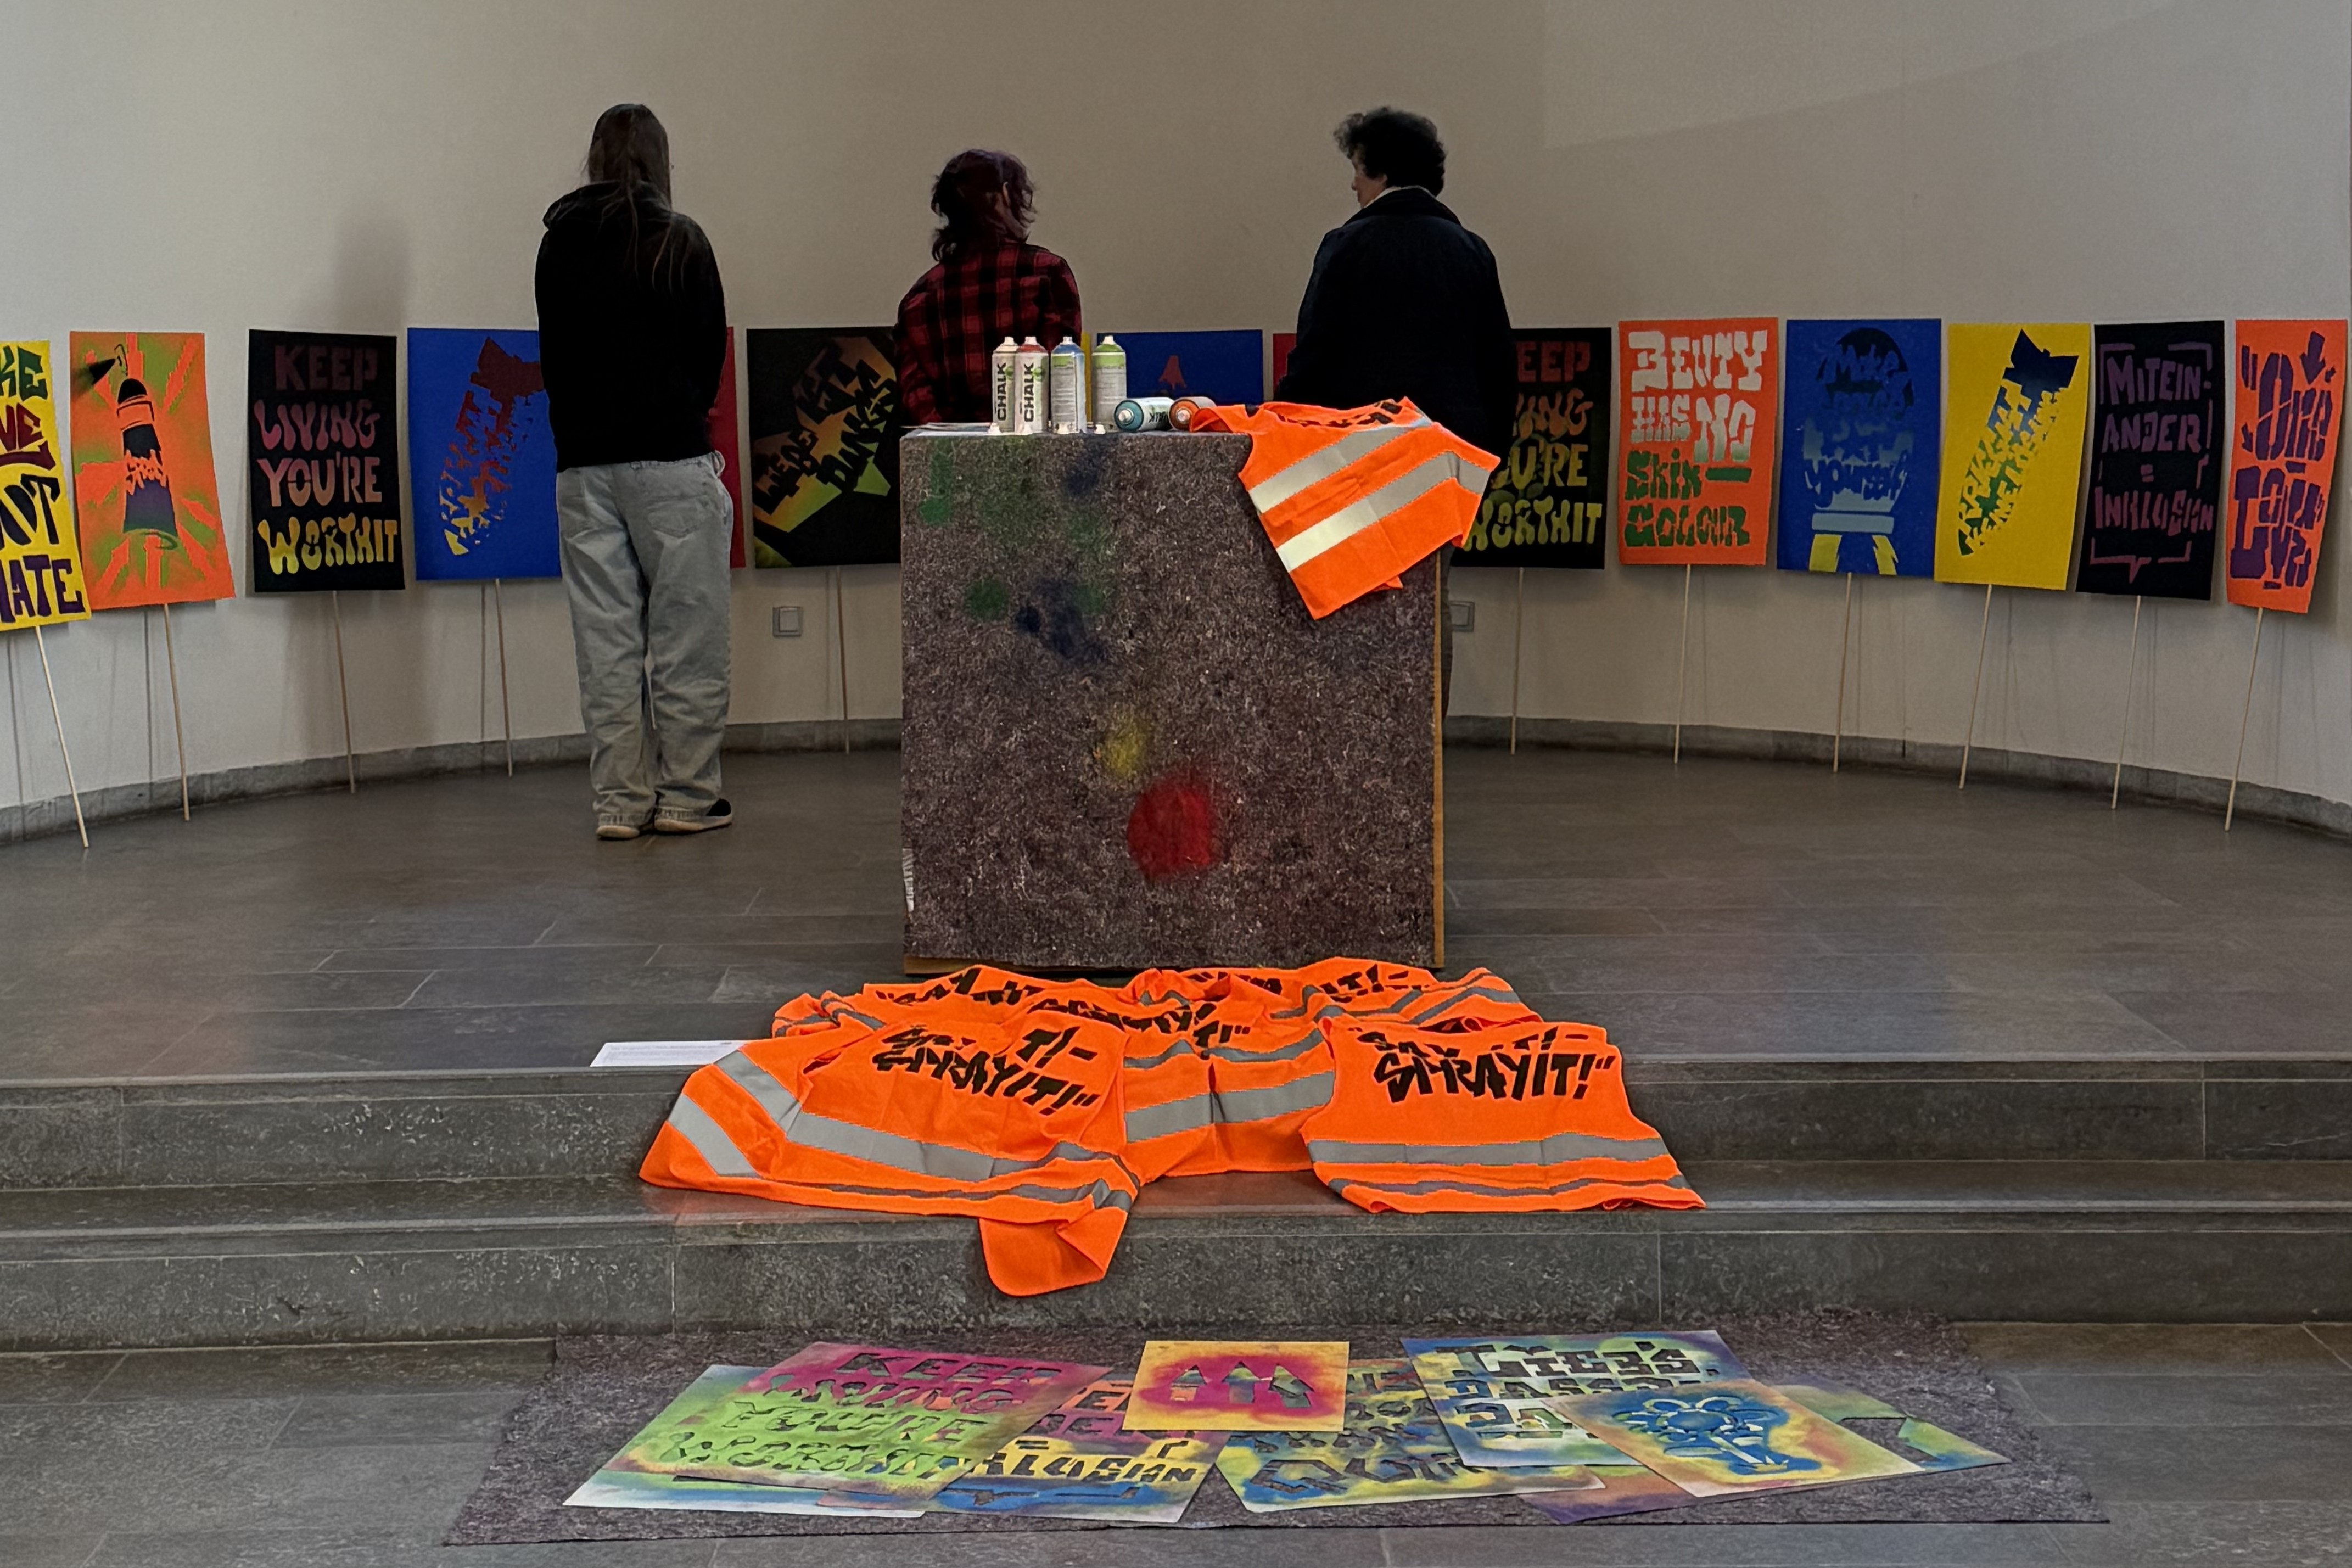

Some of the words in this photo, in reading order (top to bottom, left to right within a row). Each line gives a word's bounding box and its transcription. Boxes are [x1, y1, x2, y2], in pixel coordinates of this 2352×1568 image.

[275, 344, 378, 391] KEEP
[1516, 341, 1591, 383] EEP
[997, 362, 1006, 421] CHALK
[1024, 362, 1034, 422] CHALK
[253, 399, 381, 451] LIVING
[1630, 394, 1691, 444] HAS
[1693, 393, 1756, 463] NO
[2101, 412, 2201, 453] ANDER
[256, 451, 383, 507] YOU'RE
[0, 473, 60, 545] OT
